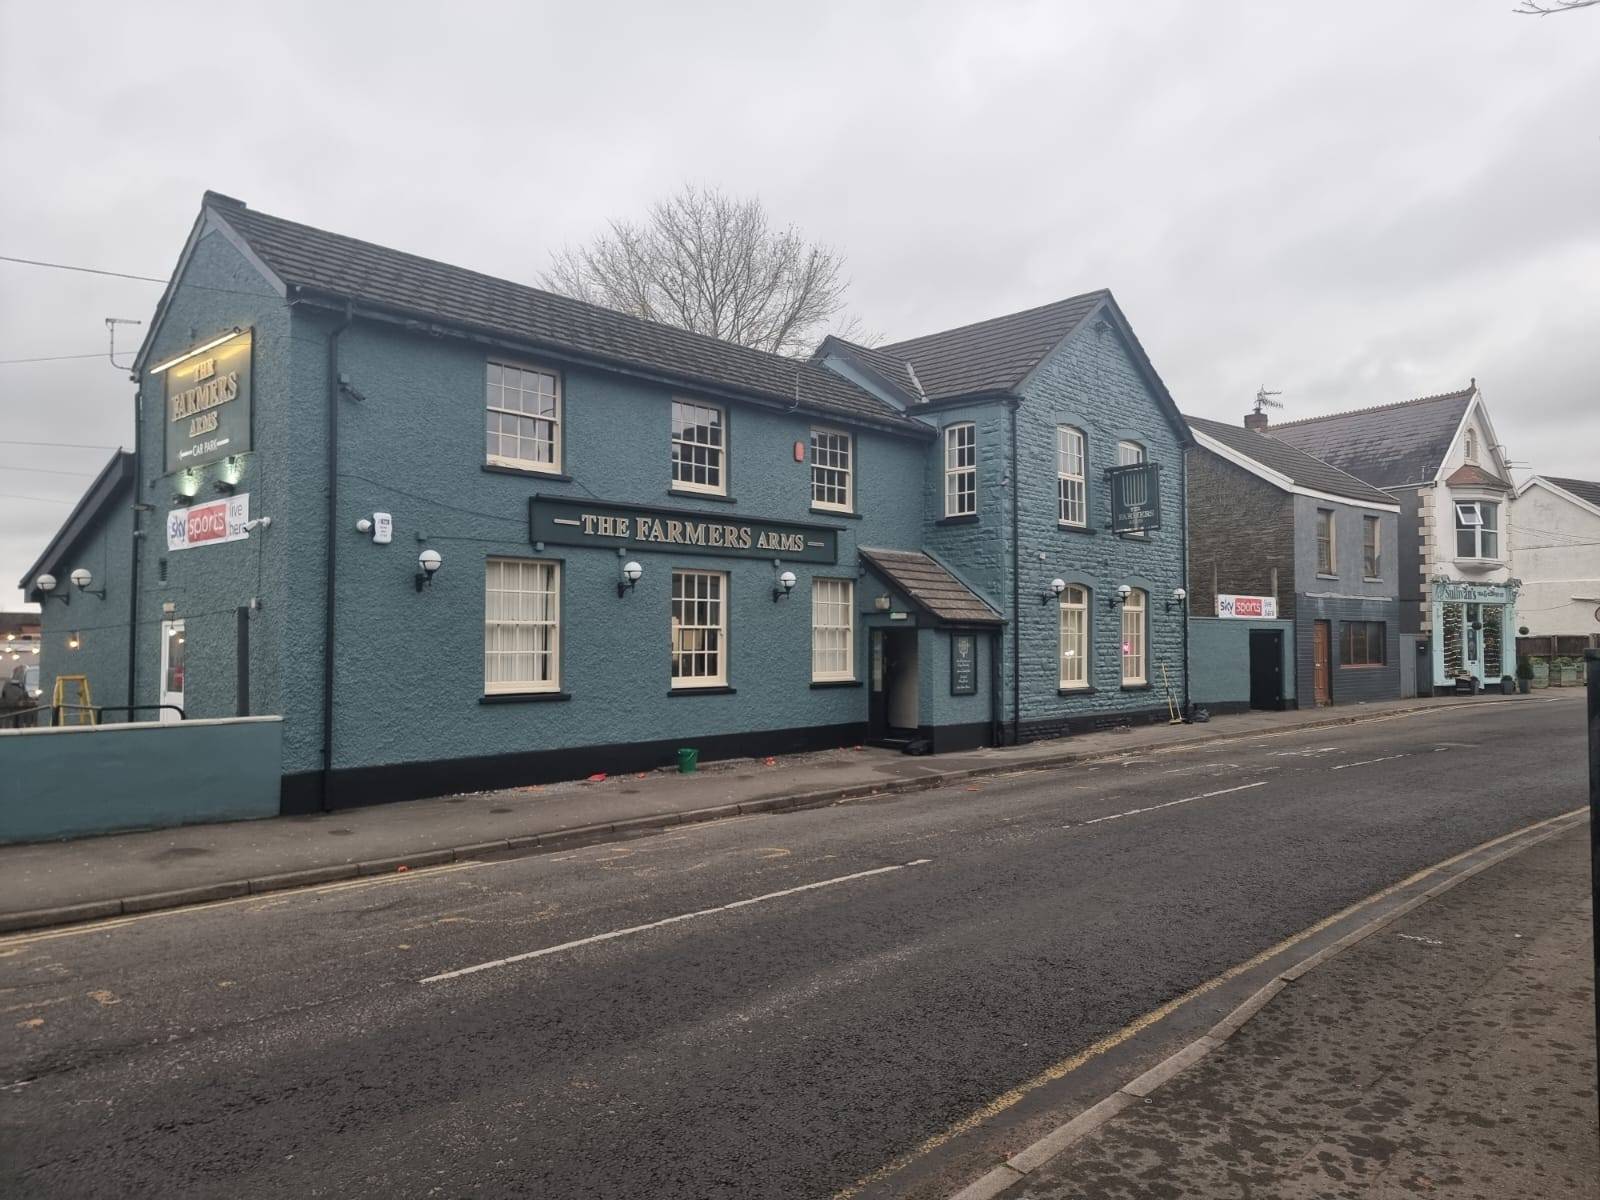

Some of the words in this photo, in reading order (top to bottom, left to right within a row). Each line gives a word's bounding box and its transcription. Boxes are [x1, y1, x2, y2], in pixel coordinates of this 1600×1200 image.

[171, 371, 237, 421] FARMERS
[189, 411, 218, 437] ARMS
[192, 445, 203, 457] CAR
[204, 440, 217, 453] PARK
[230, 503, 243, 518] live
[171, 516, 186, 542] sky
[189, 511, 224, 539] sports
[581, 514, 629, 537] THE
[635, 517, 750, 548] FARMERS
[756, 531, 804, 551] ARMS
[1220, 600, 1233, 614] sky
[1237, 602, 1260, 614] sports
